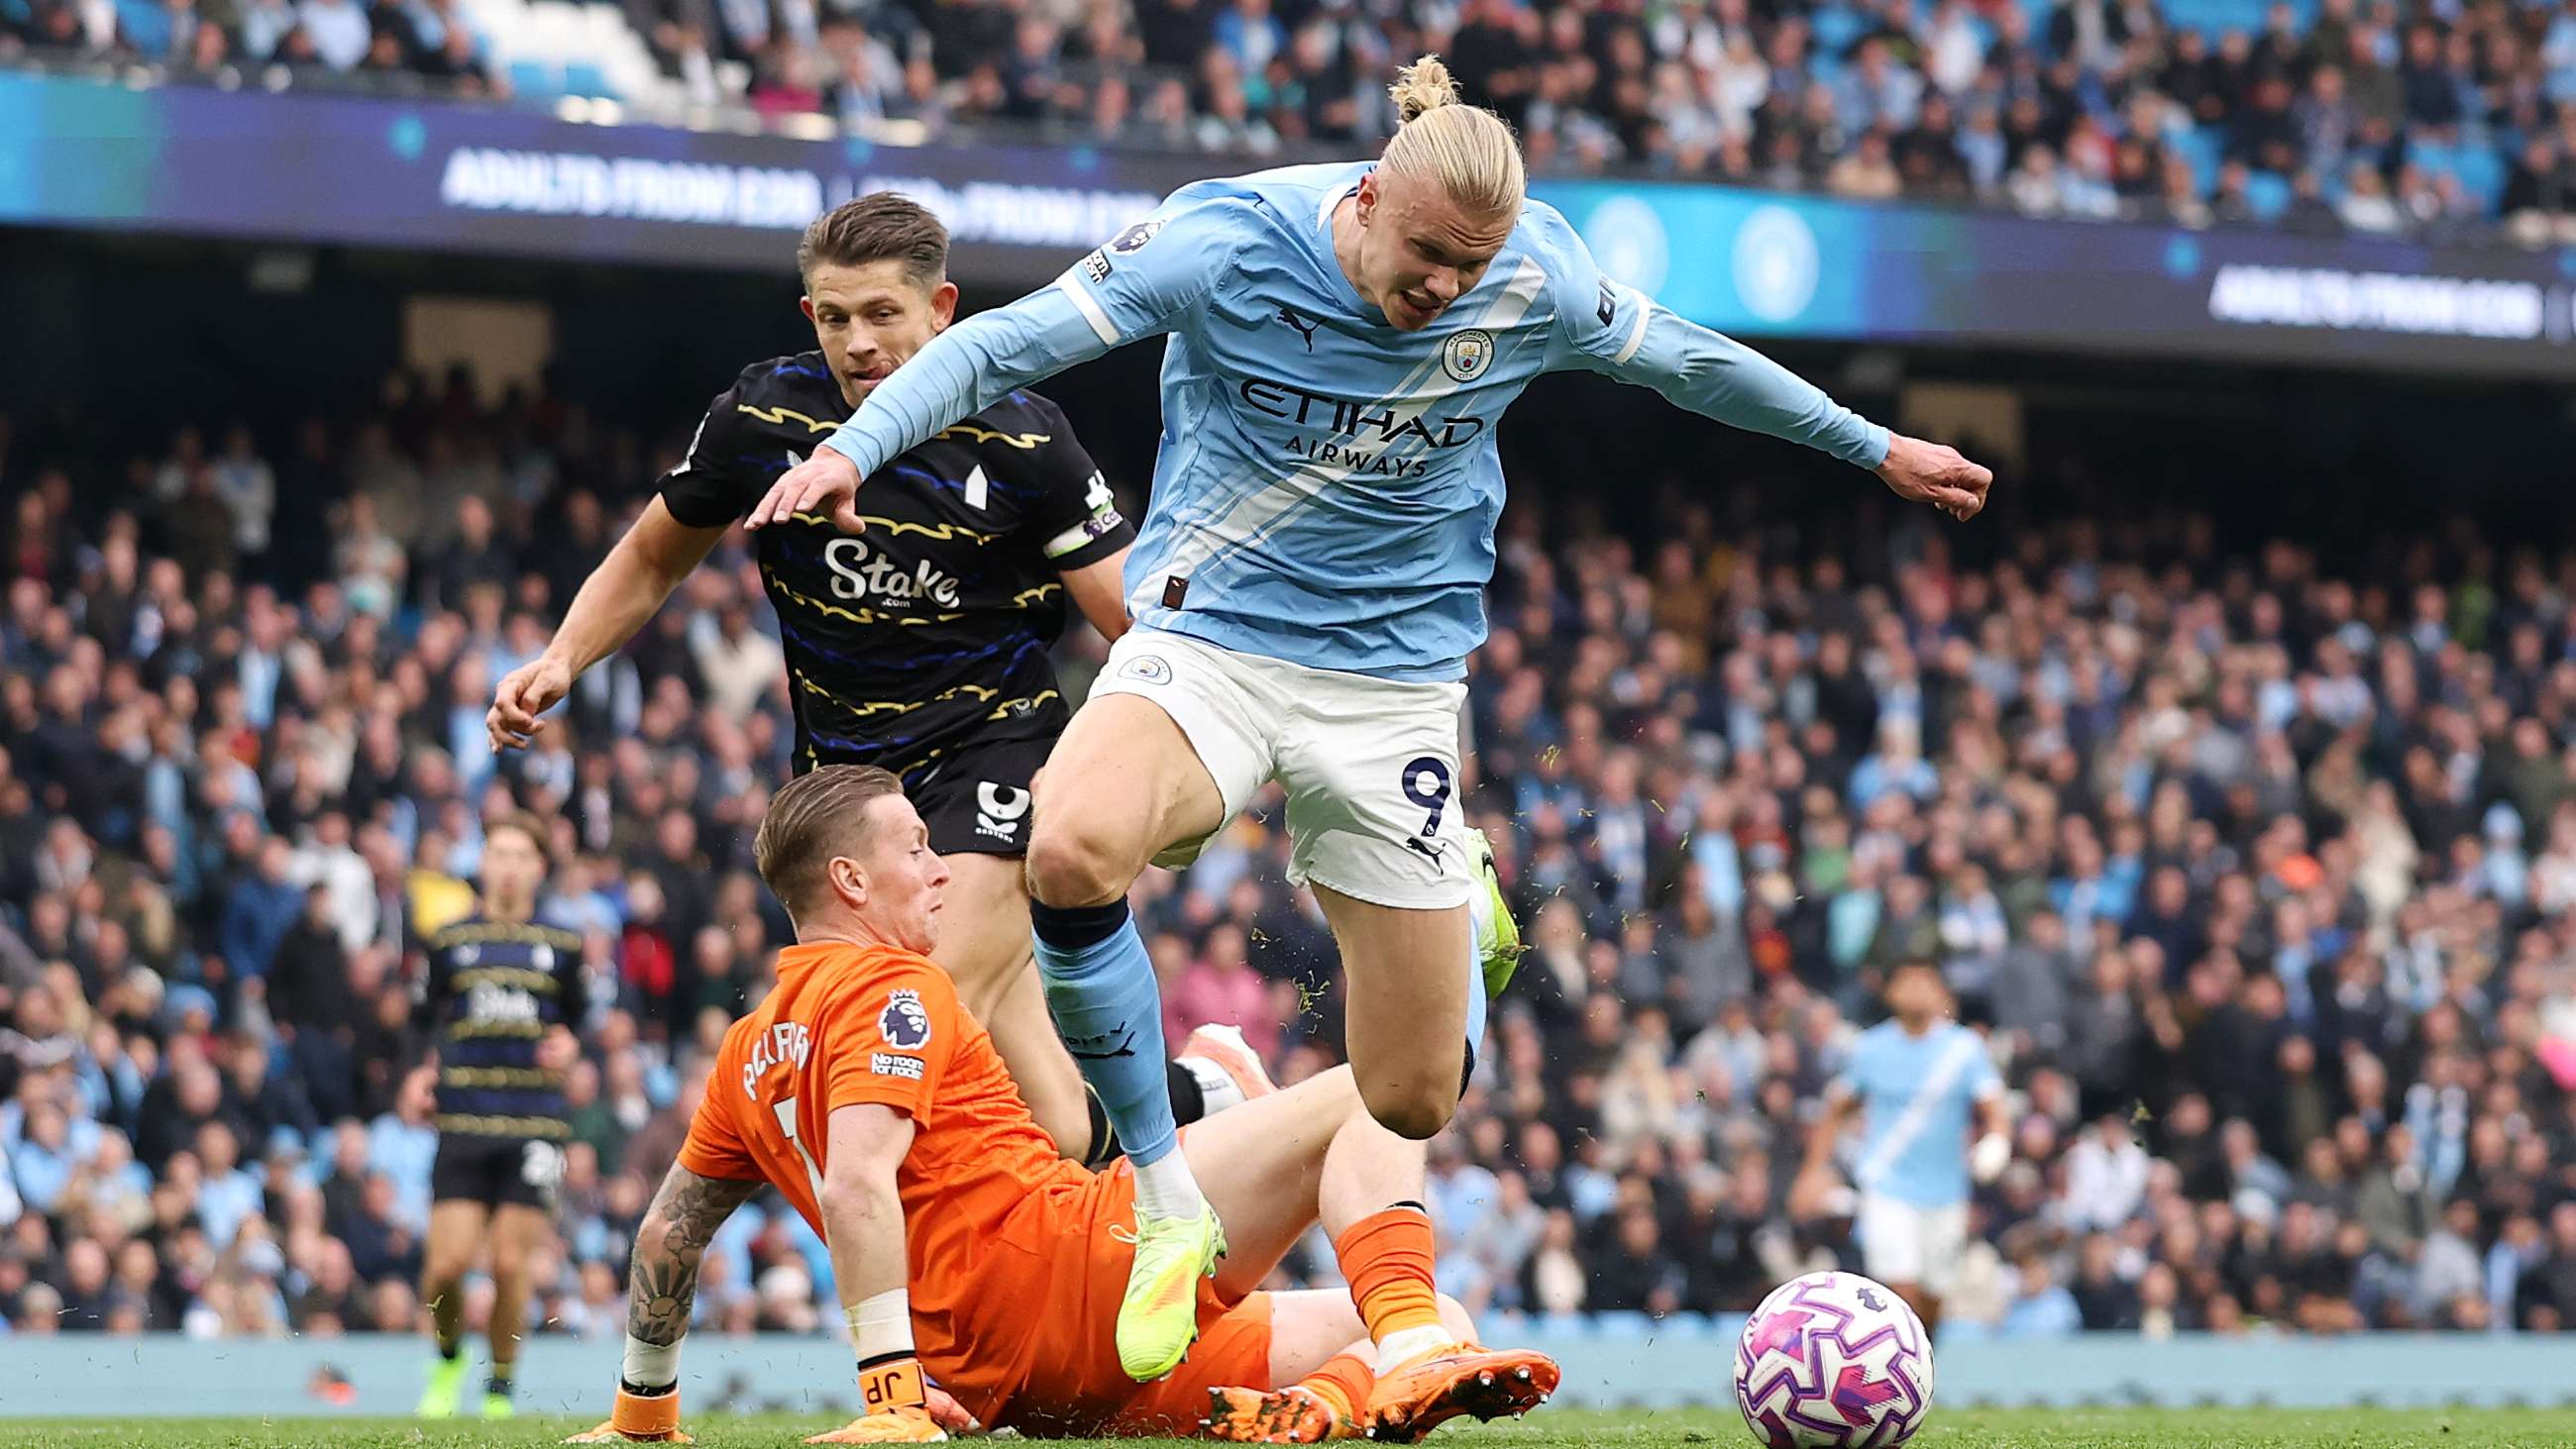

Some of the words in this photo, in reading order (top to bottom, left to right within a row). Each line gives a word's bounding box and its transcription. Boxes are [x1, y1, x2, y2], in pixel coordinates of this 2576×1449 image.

[1240, 377, 1484, 449] ETIHAD
[1284, 435, 1429, 478] AIRWAYS
[824, 538, 960, 609] Stake
[881, 597, 911, 608] .com
[1401, 756, 1451, 837] 9
[872, 1053, 893, 1066] No
[866, 1372, 902, 1404] JP
